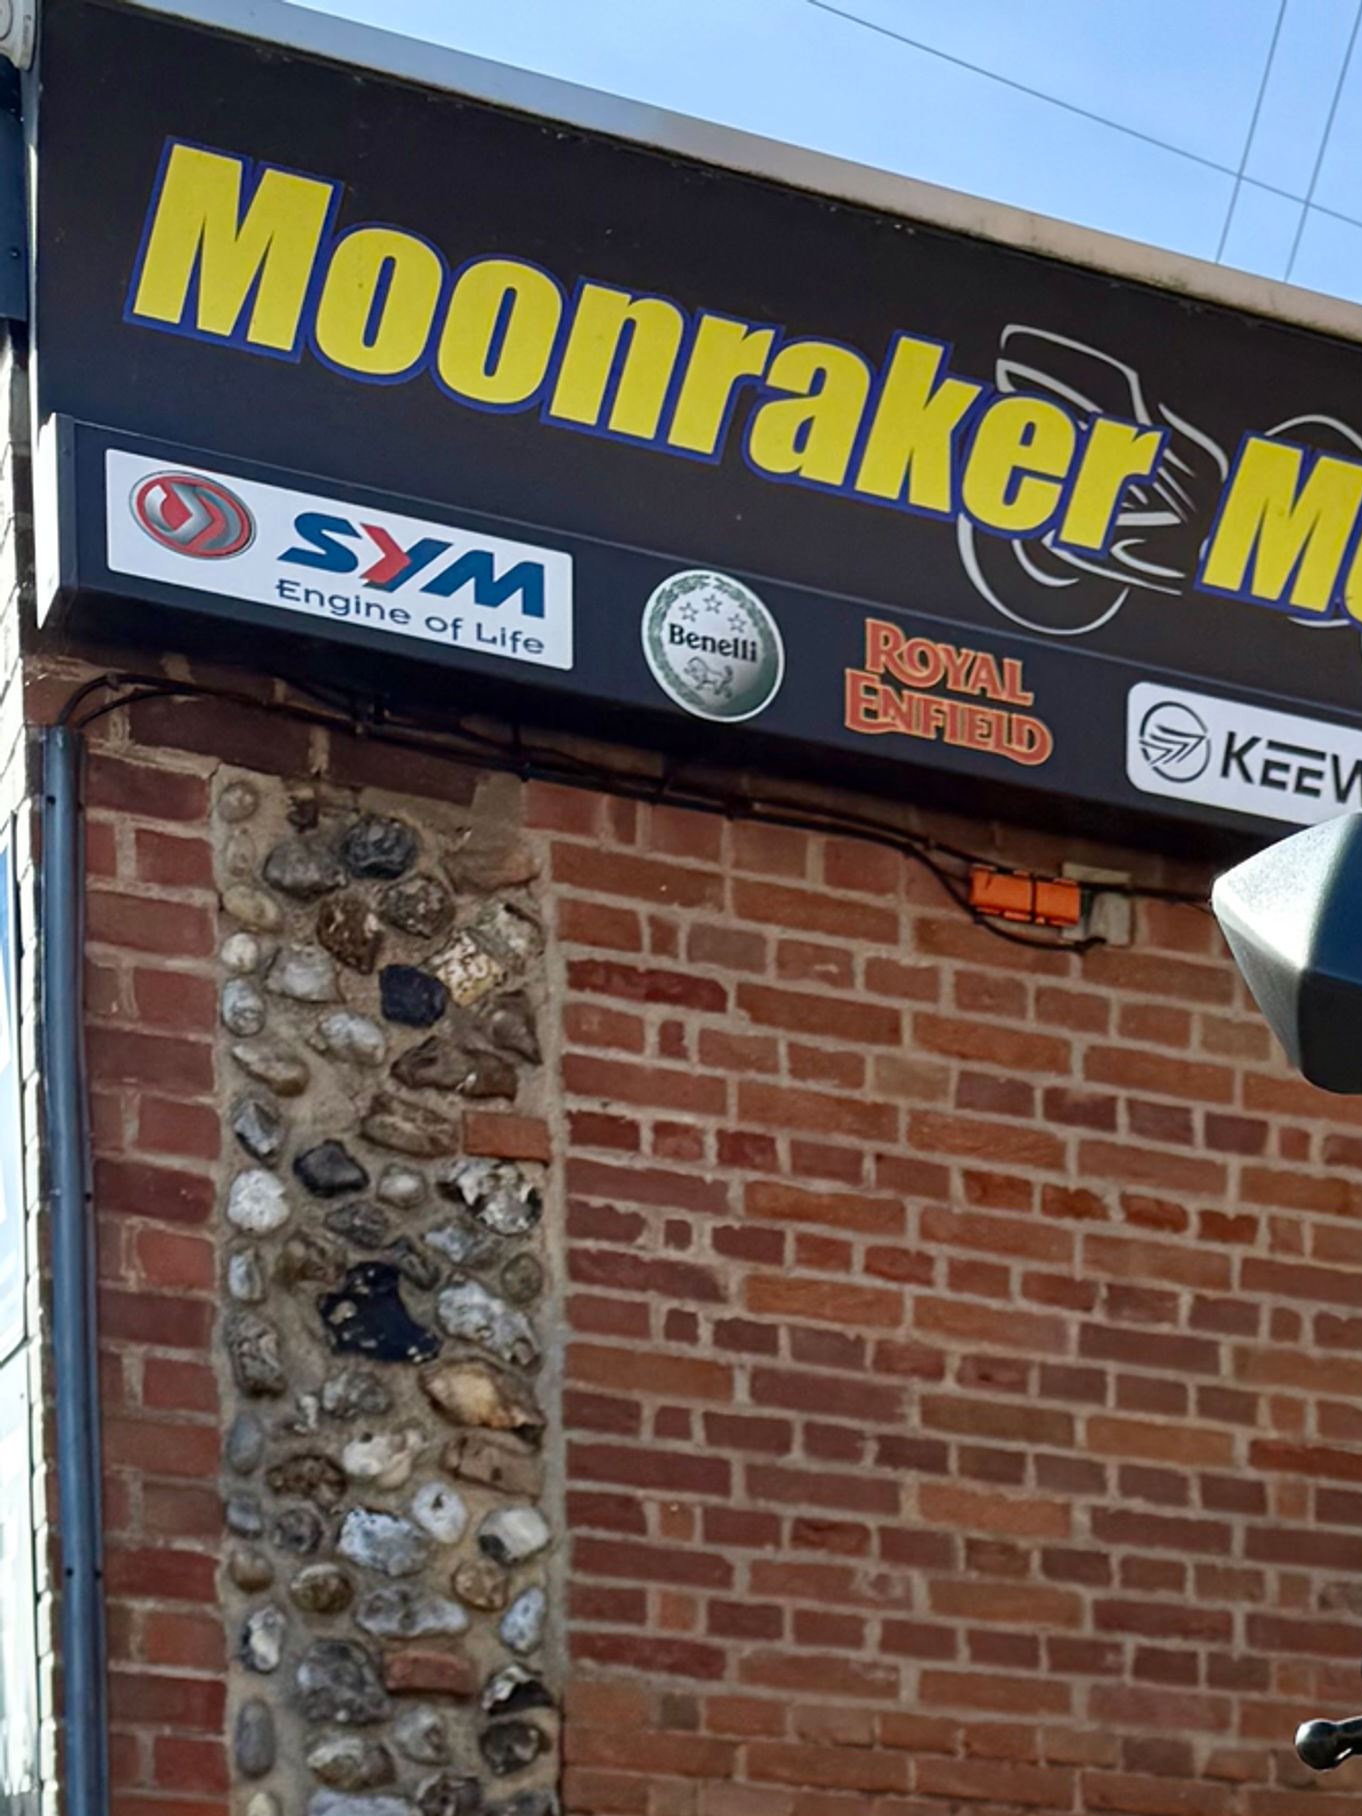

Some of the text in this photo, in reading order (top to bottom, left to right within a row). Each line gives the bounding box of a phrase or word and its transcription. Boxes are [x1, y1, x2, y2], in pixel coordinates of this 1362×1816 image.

[126, 136, 1165, 556] Moonraker
[276, 512, 545, 620] SYM
[275, 578, 545, 655] Engine of Life
[668, 622, 758, 664] Benelli
[864, 617, 1035, 706] ROYAL
[844, 668, 1054, 766] ENFIELD
